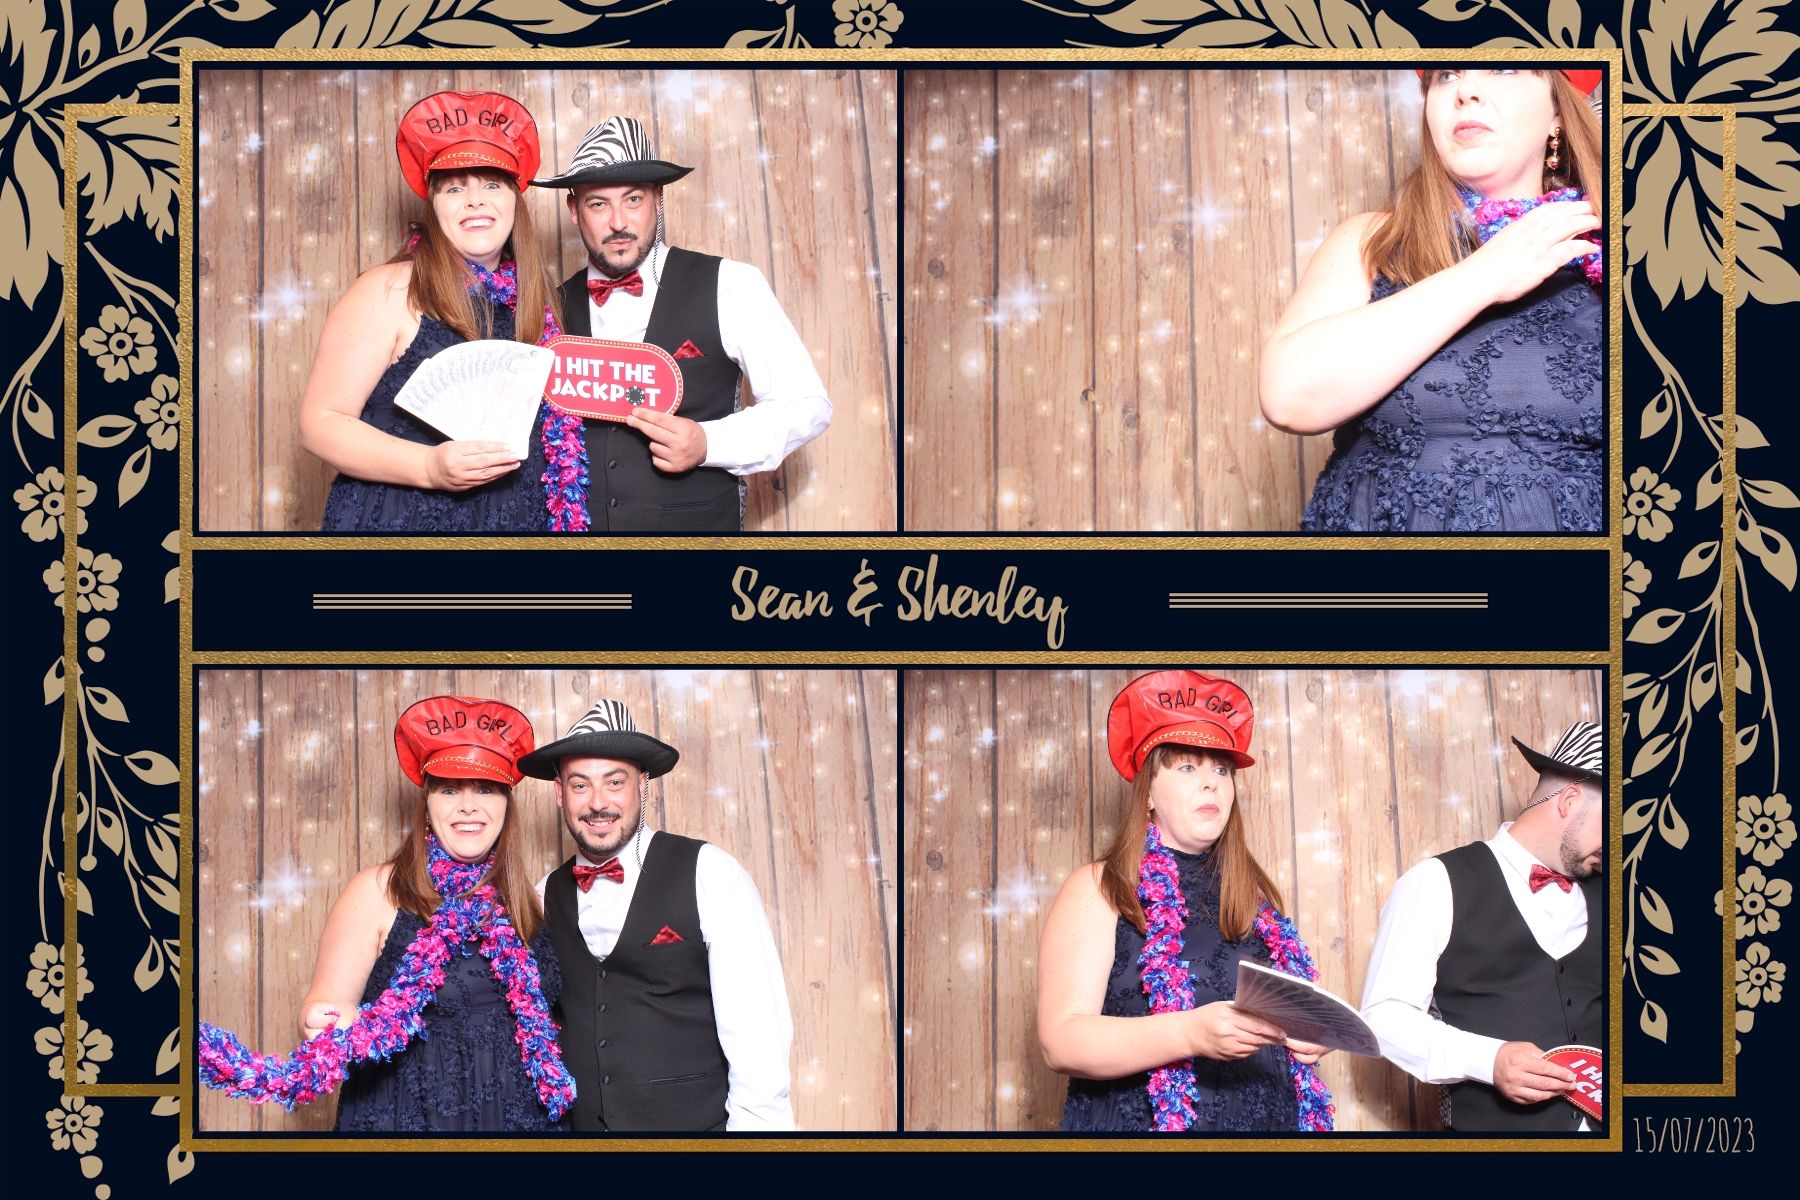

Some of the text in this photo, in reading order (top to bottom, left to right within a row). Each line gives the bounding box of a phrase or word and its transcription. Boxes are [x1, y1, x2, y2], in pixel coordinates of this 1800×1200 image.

[426, 108, 515, 137] BAD GIRL
[554, 356, 656, 384] I HIT THE
[1158, 688, 1197, 709] BAD
[425, 711, 513, 741] BAD GIRL
[1569, 1059, 1588, 1069] I
[1574, 1074, 1602, 1106] CK
